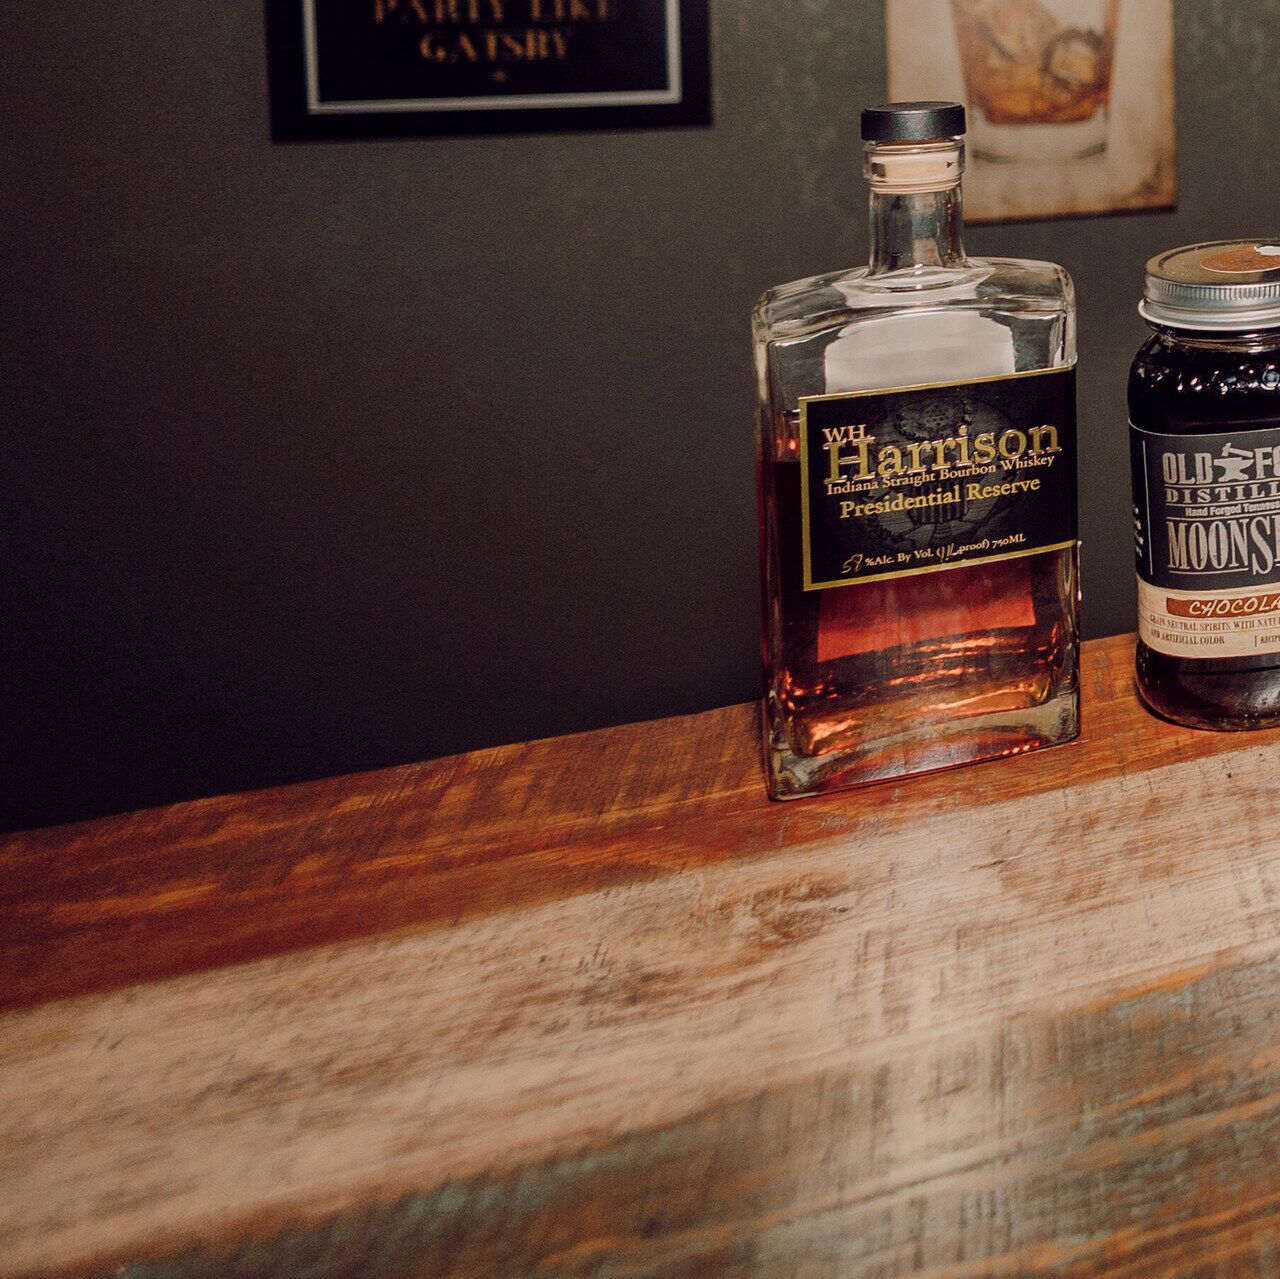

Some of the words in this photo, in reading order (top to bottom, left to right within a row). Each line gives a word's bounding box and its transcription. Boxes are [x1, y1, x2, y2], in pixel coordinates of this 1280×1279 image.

[419, 27, 573, 63] GATSBY
[822, 424, 1062, 485] Harrison
[1162, 452, 1214, 484] OLD
[825, 481, 879, 496] Indiana
[882, 472, 936, 487] Straight
[940, 464, 997, 481] Bourbon
[1000, 455, 1056, 471] Whiskey
[839, 484, 962, 519] Presidential
[965, 478, 1042, 501] Reserve
[1185, 506, 1208, 517] Hand
[1210, 504, 1241, 516] Forged
[897, 553, 912, 563] By
[992, 533, 1027, 549] 750ML
[1161, 631, 1199, 645] ARTIFICIAL
[1200, 635, 1225, 646] COLOR
[1168, 621, 1199, 632] NEUTRAL
[1200, 622, 1231, 632] SPIRITS
[1234, 620, 1255, 630] WITH
